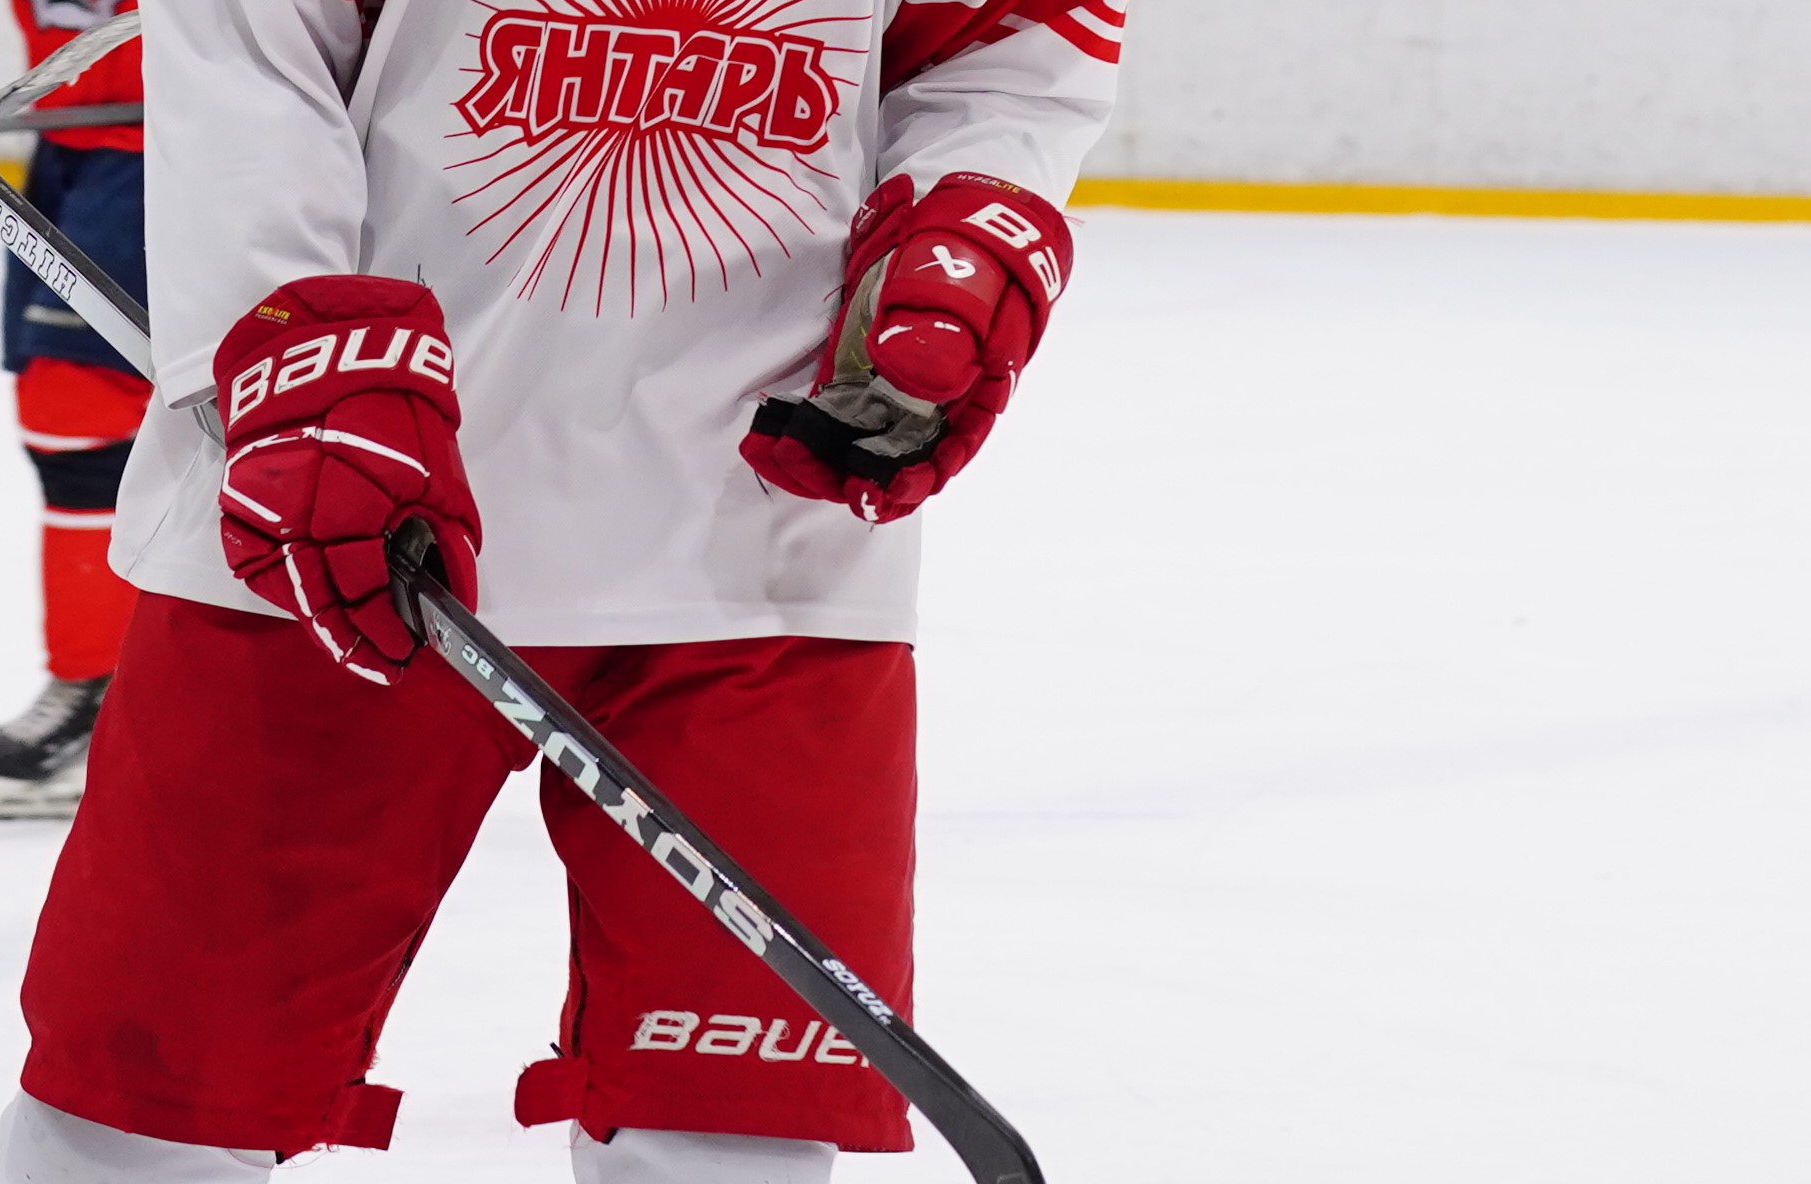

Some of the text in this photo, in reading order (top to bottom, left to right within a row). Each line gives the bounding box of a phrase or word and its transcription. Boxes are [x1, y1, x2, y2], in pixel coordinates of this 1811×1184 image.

[456, 11, 840, 154] ЯНТАРЬ
[228, 325, 457, 432] BAUE
[461, 644, 775, 958] SOYUZ BC
[629, 1009, 870, 1068] BAUE
[821, 957, 893, 1018] SOYUZ
